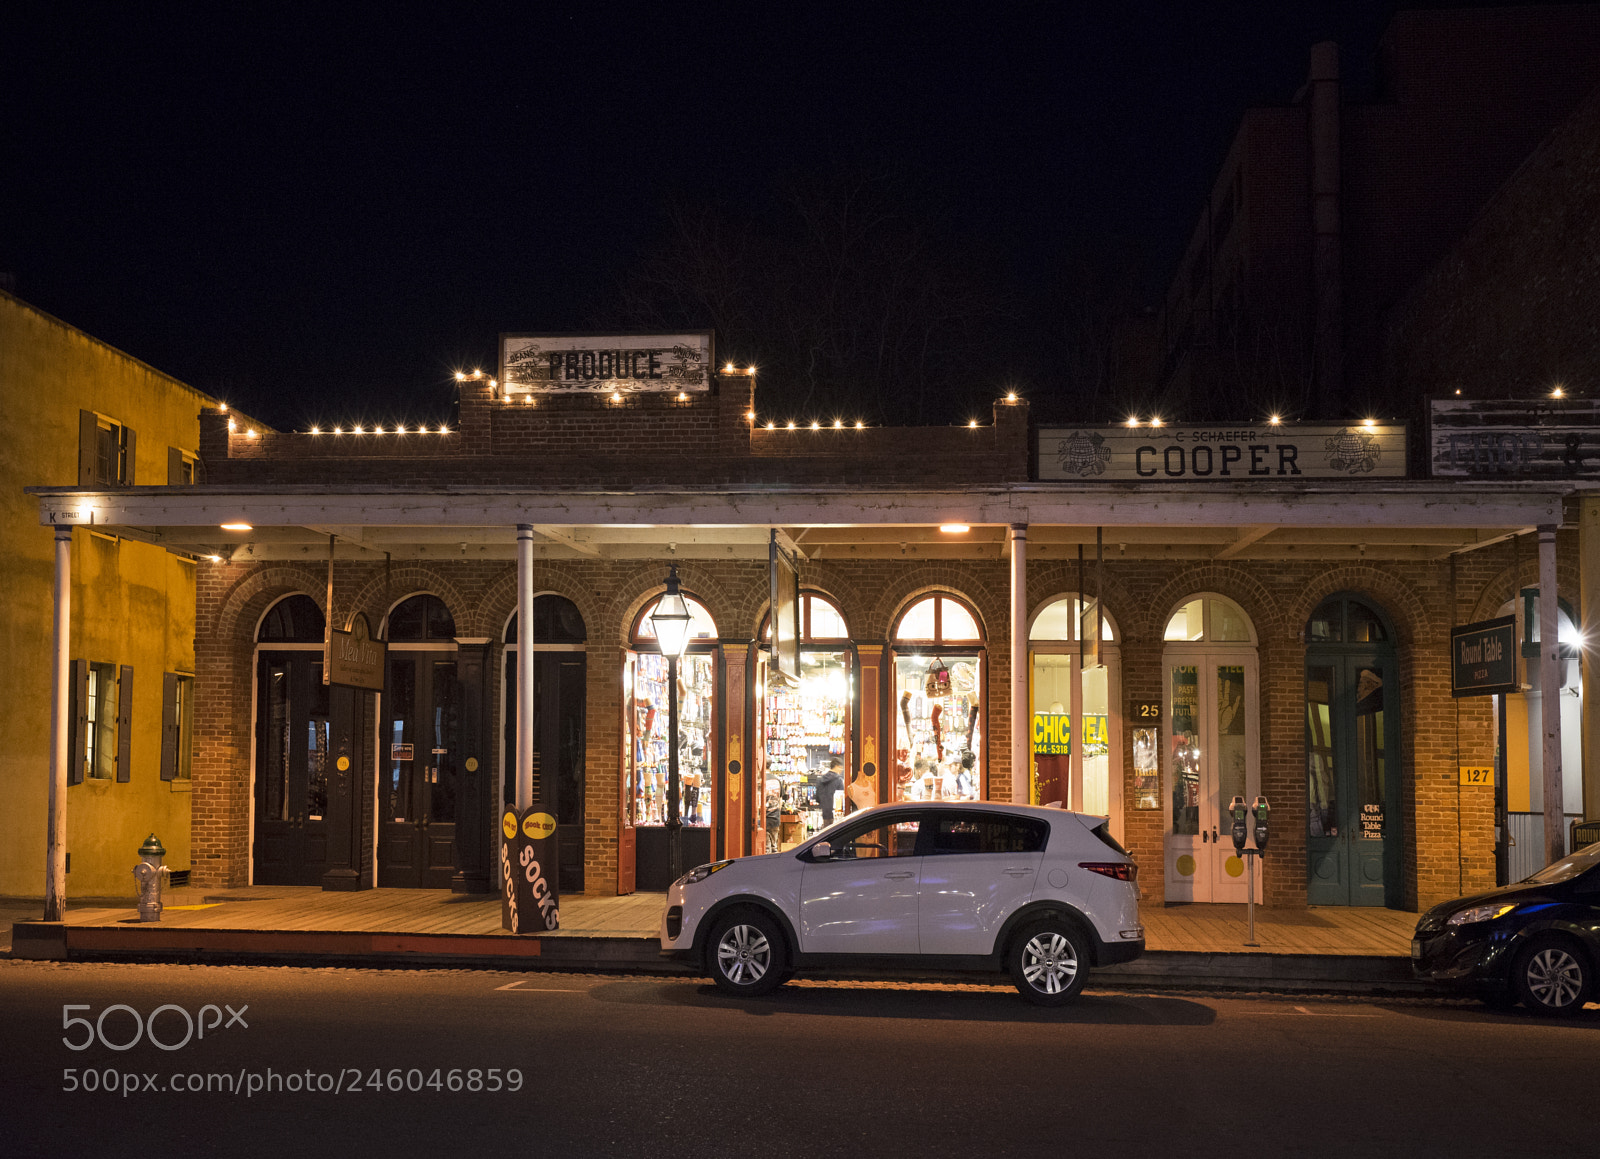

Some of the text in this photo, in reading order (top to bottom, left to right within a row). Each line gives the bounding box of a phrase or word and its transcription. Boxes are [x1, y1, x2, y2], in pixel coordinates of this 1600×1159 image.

[549, 349, 663, 381] PRODUCE
[1191, 430, 1257, 443] SCHAEFER
[1135, 444, 1302, 477] COOPER
[49, 512, 56, 523] K
[338, 637, 359, 663] Mea
[1461, 635, 1502, 665] Round Table
[1178, 686, 1194, 694] PAST
[1034, 715, 1070, 744] CHIC
[1467, 769, 1490, 783] 127
[1360, 813, 1384, 821] Round
[1362, 821, 1382, 830] Table
[1363, 830, 1382, 838] Pizza
[1576, 828, 1600, 843] ROUN
[501, 842, 519, 934] SOCKS
[520, 845, 559, 930] SOCKS
